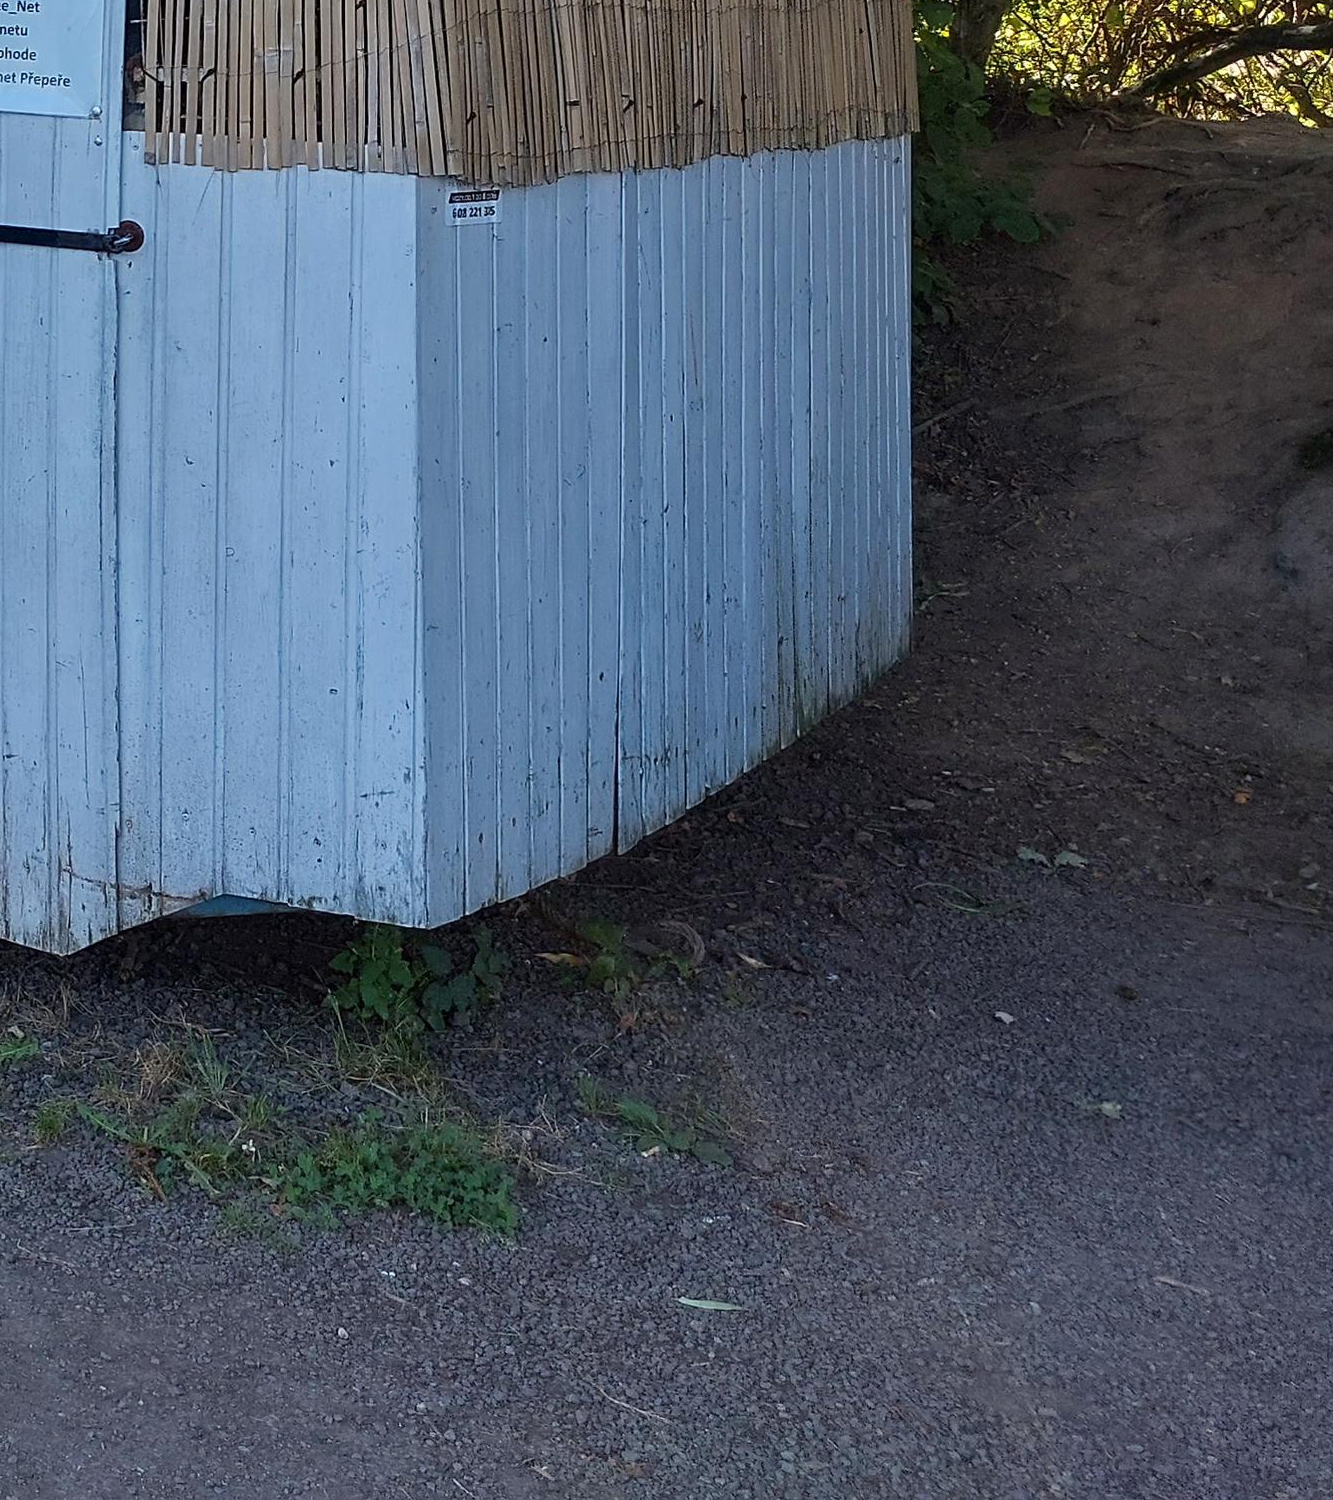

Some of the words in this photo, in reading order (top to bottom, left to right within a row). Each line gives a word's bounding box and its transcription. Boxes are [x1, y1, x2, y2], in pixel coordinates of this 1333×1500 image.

[20, 71, 71, 88] Přepeře
[452, 207, 467, 219] 608
[469, 206, 482, 218] 221
